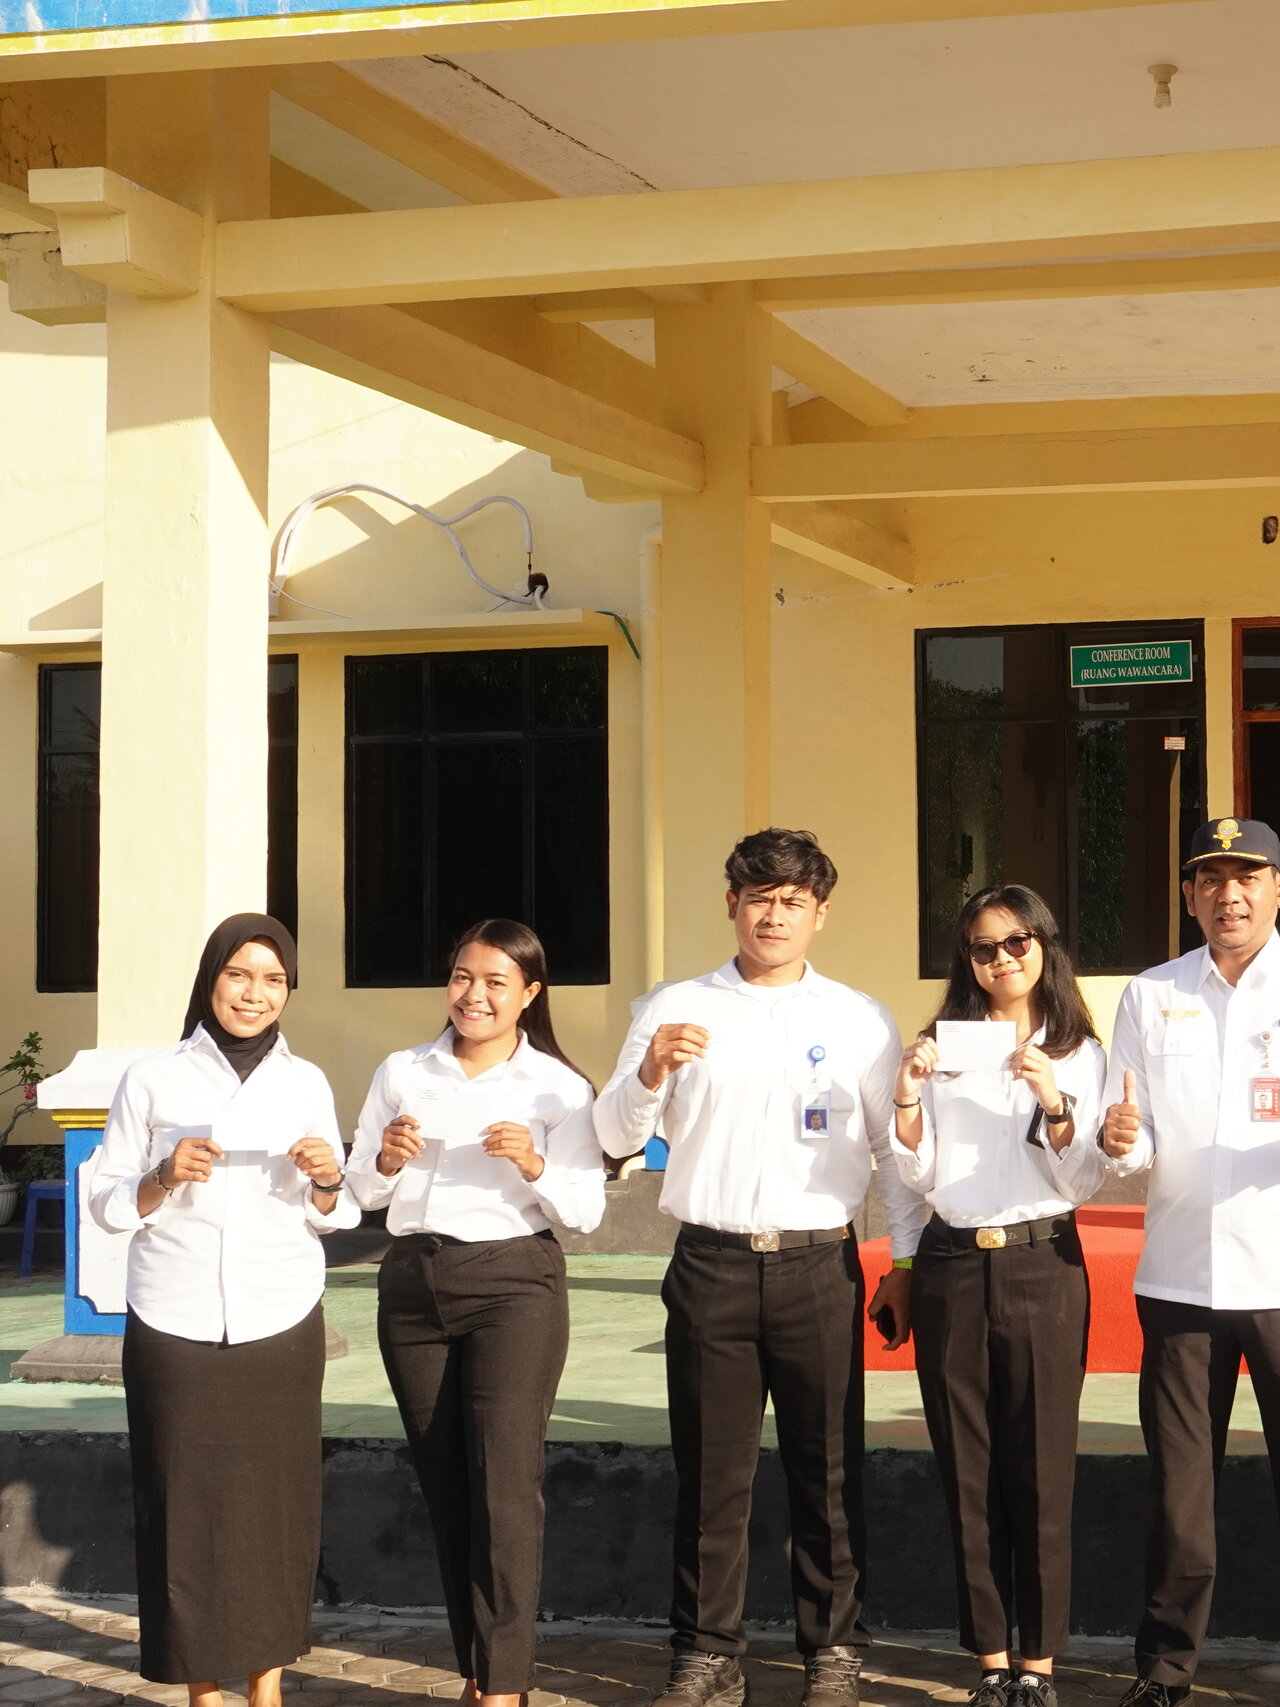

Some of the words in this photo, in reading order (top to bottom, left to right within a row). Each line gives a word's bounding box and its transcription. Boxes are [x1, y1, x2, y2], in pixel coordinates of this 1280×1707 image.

[1091, 648, 1143, 662] CONFERENCE
[1145, 647, 1170, 659] ROOM
[1081, 667, 1116, 681] (RUANG
[1117, 665, 1182, 677] WAWANCARA)
